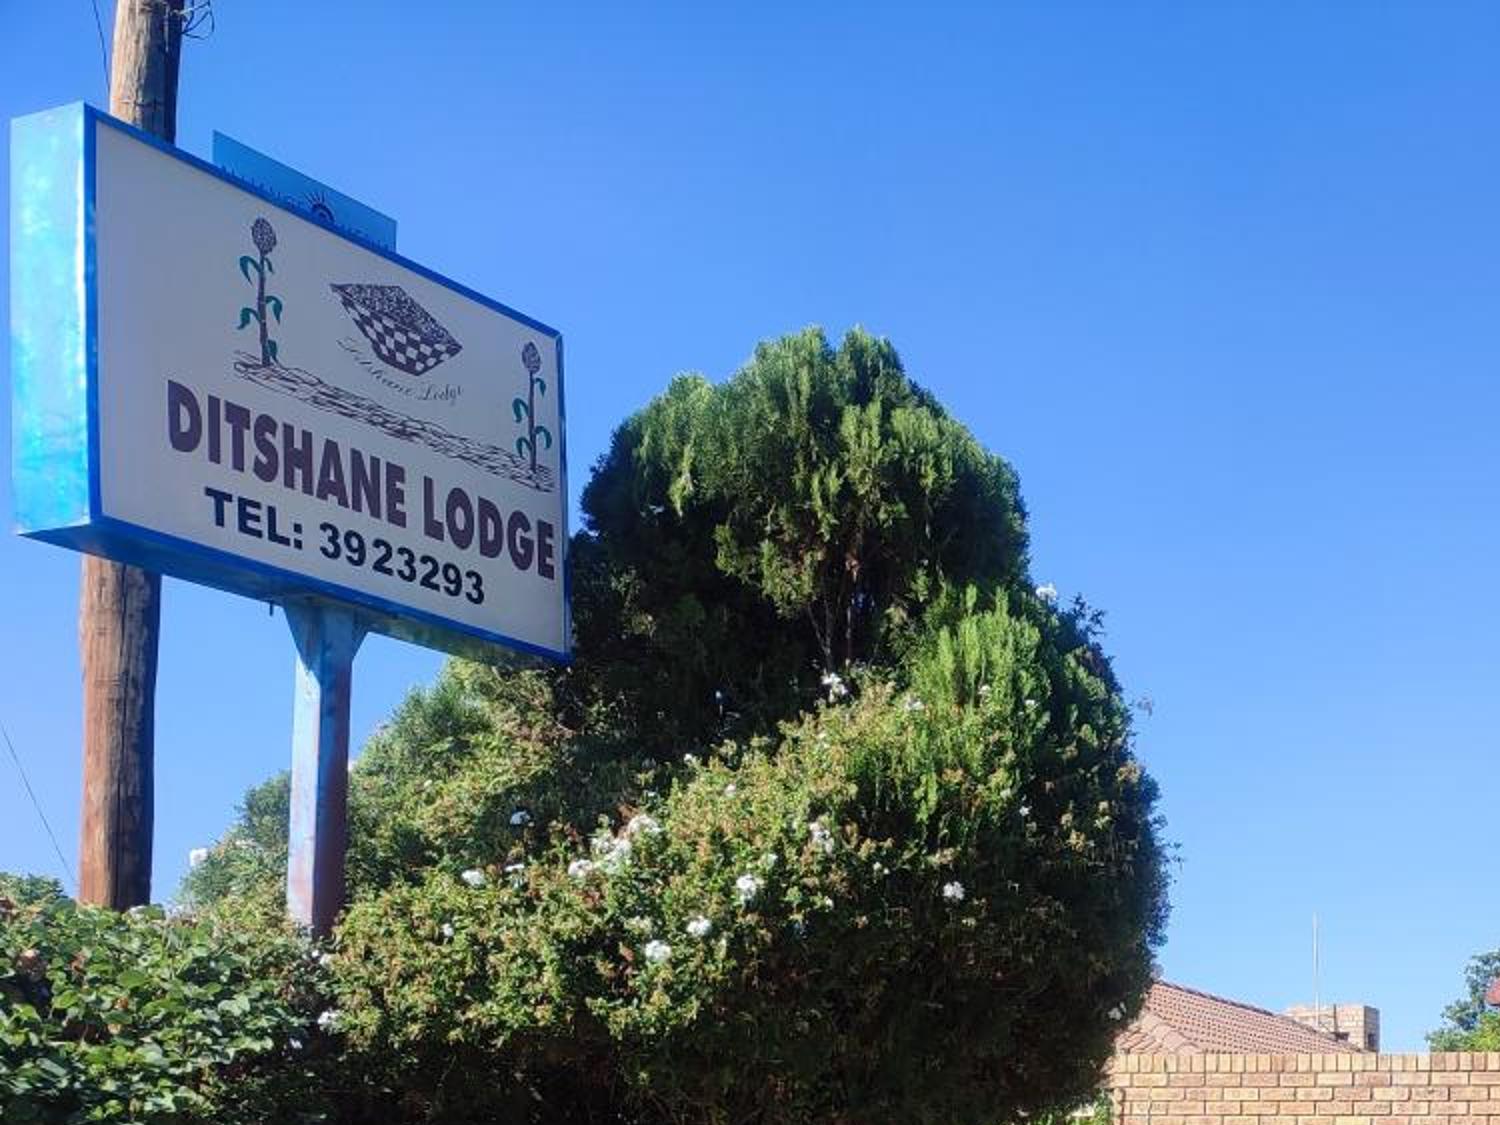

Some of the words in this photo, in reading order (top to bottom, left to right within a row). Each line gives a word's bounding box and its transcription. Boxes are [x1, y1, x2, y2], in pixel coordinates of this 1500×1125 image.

[167, 380, 407, 528] DITSHANE
[423, 475, 556, 580] LODGE
[205, 486, 303, 550] TEL:
[319, 521, 485, 605] 3923293
